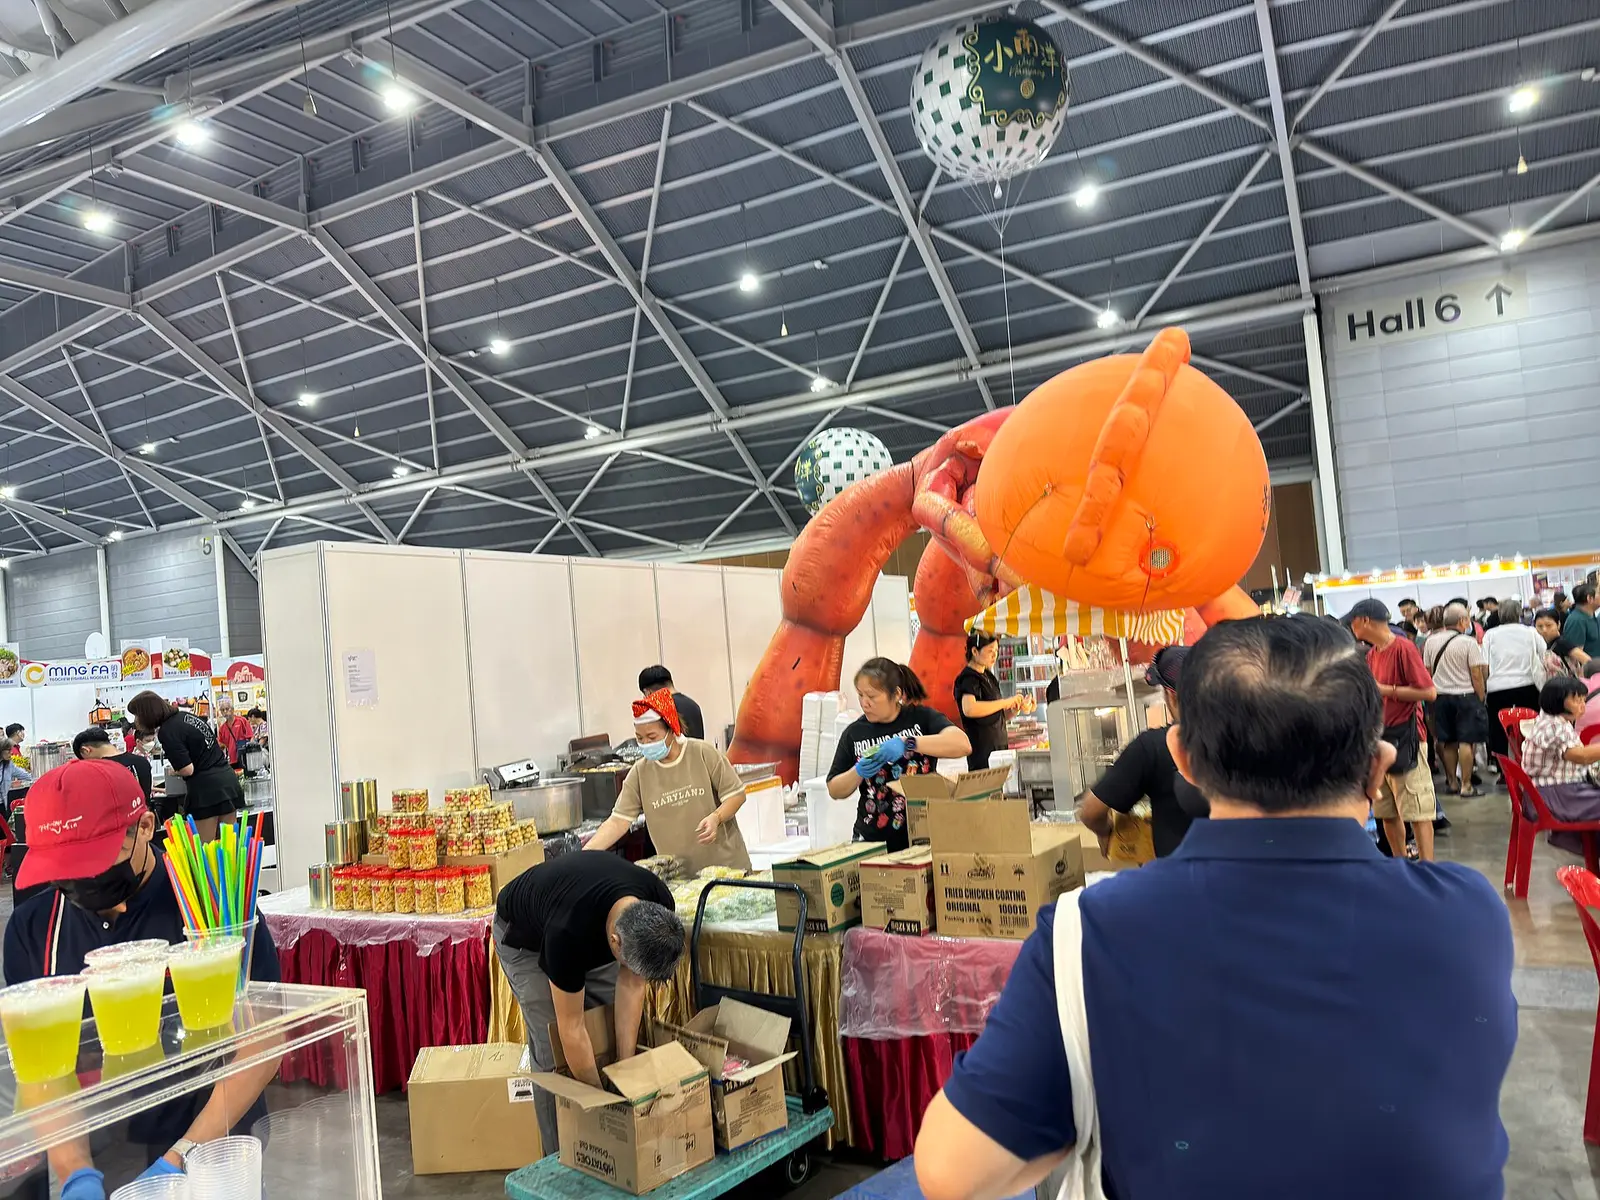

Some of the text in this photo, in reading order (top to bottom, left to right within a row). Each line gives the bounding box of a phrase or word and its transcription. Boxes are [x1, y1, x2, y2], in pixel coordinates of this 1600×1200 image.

[1347, 293, 1461, 341] Hall 6
[203, 537, 212, 556] 5
[91, 665, 109, 675] FA
[652, 787, 705, 809] MARYLAND
[944, 887, 1027, 902] FRIED CHICKEN COATING
[946, 901, 981, 913] ORIGINAL
